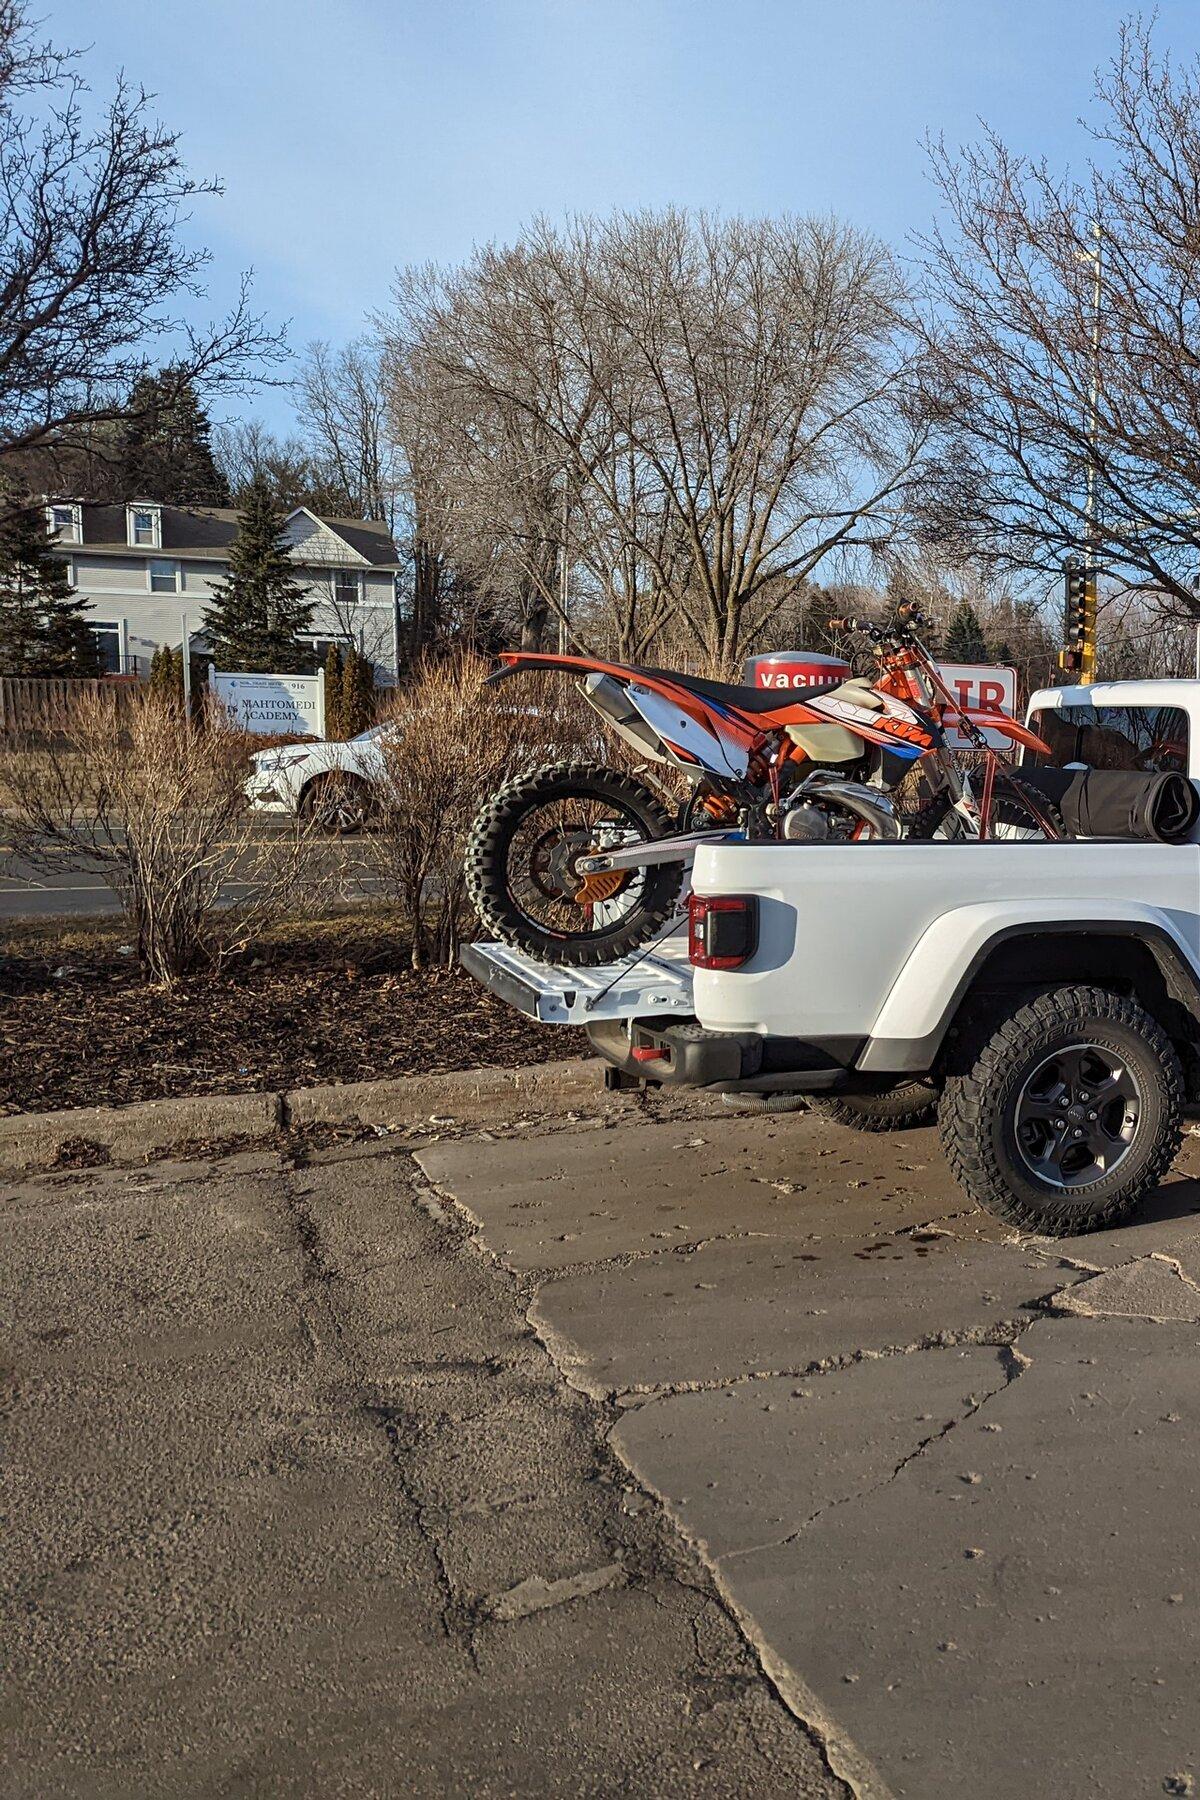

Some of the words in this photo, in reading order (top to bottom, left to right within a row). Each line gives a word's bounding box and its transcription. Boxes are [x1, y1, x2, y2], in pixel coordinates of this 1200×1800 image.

[242, 699, 316, 710] MAHTOMEDI
[242, 710, 299, 721] ACADEMY
[872, 716, 933, 747] KTM
